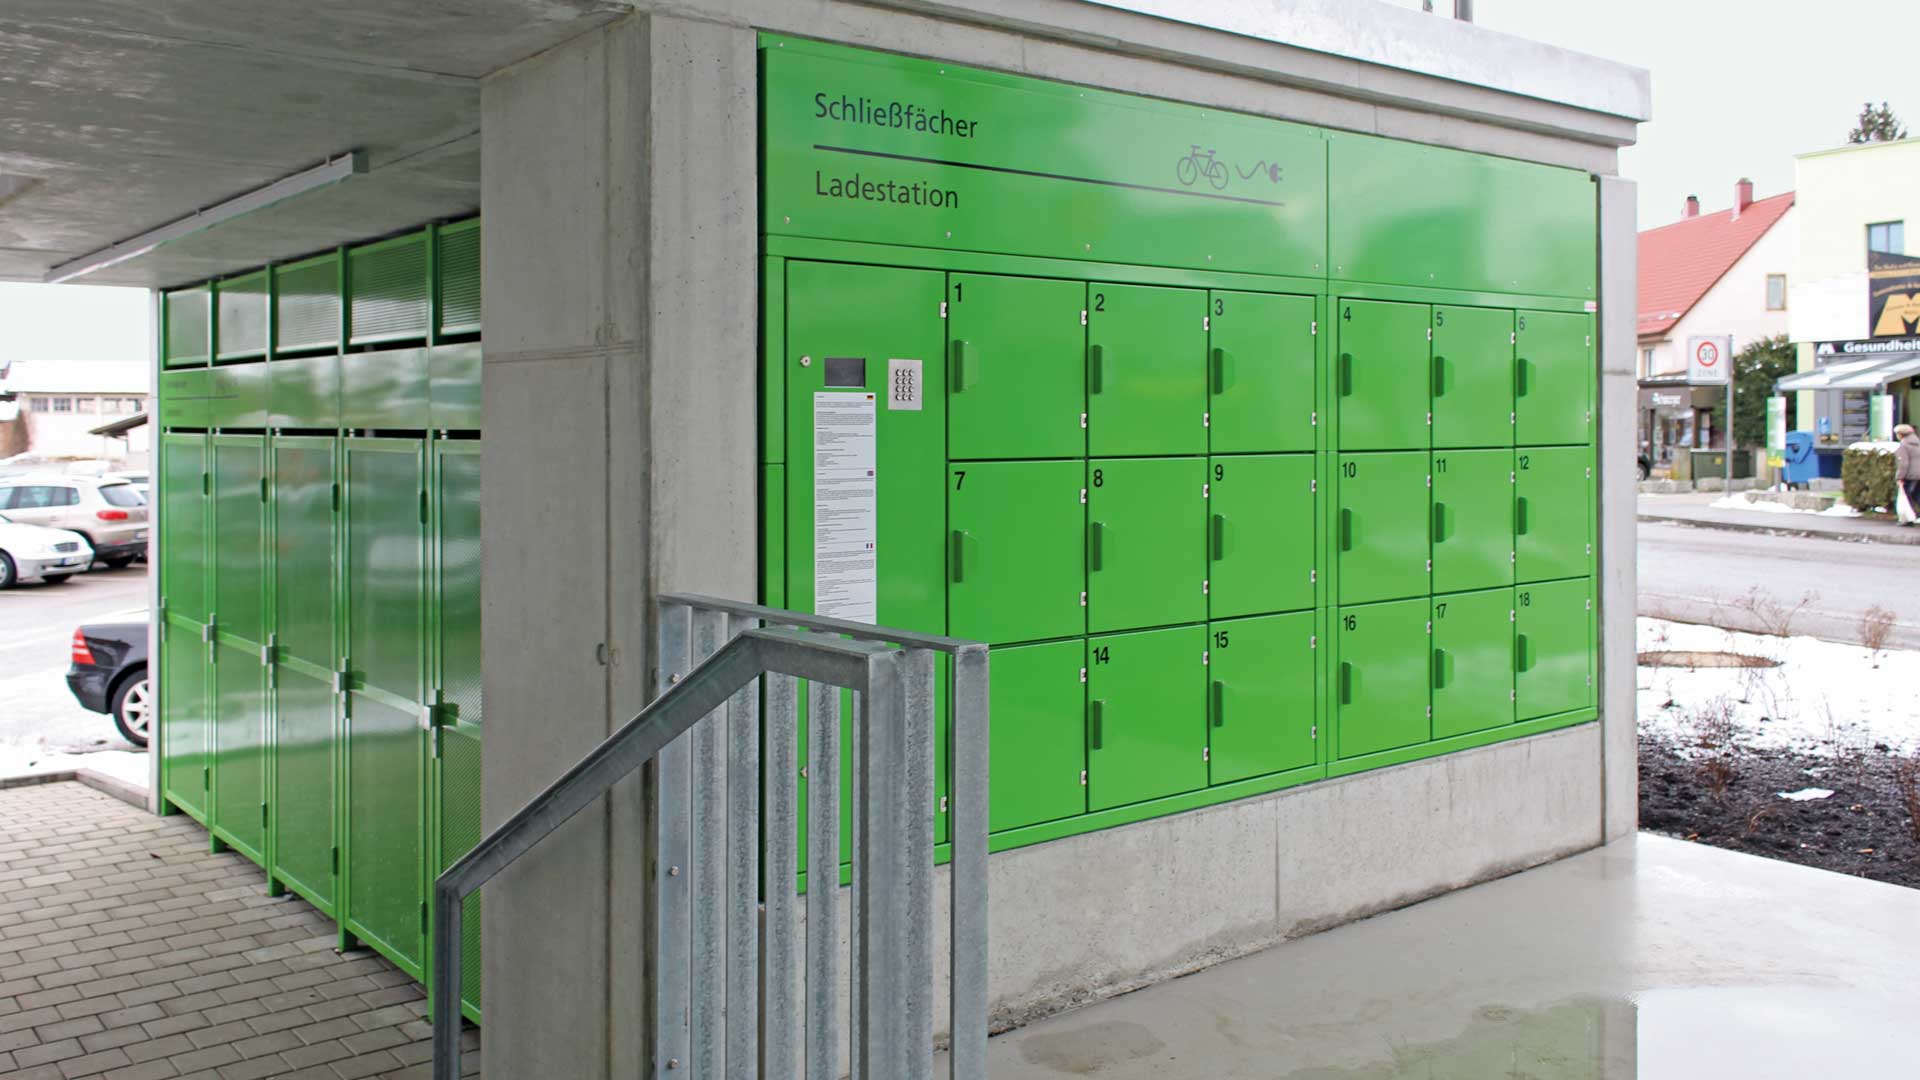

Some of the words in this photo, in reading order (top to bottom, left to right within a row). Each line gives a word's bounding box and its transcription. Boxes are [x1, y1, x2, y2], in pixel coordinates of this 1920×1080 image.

[814, 92, 979, 139] Schließfächer
[815, 170, 960, 209] Ladestation
[953, 282, 963, 303] 1
[1094, 293, 1105, 313] 2
[1213, 298, 1224, 317] 3
[1343, 306, 1352, 322] 4
[1436, 311, 1444, 327] 5
[1518, 315, 1526, 331] 6
[1702, 348, 1715, 361] 30
[1342, 461, 1357, 479] 10
[1435, 458, 1447, 473] 11
[1518, 455, 1530, 471] 12
[953, 470, 967, 491] 7
[1092, 469, 1104, 488] 8
[1214, 463, 1224, 482] 9
[1518, 592, 1530, 608] 18
[1435, 602, 1447, 619] 17
[1343, 614, 1357, 632] 16
[1213, 630, 1229, 649] 15
[1092, 646, 1110, 666] 14
